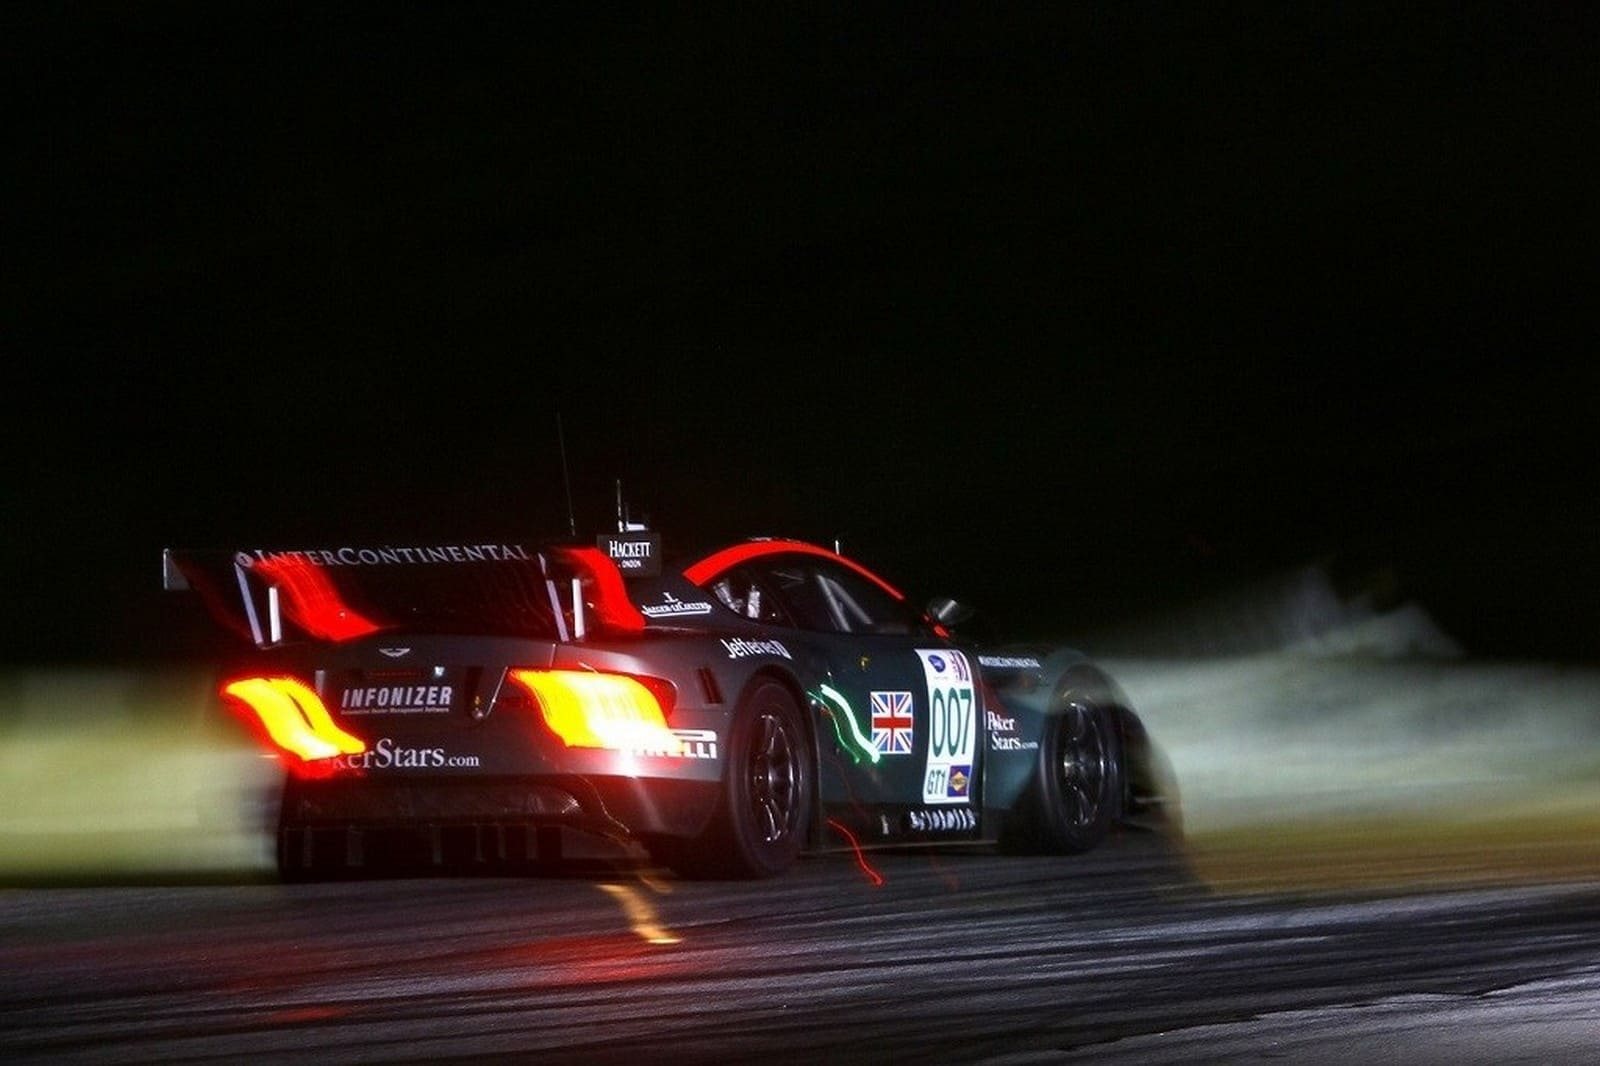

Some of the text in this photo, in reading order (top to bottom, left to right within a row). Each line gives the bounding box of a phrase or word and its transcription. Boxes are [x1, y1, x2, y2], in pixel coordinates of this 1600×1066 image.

[609, 540, 651, 557] HACKETT
[616, 559, 642, 568] ONDON
[341, 686, 452, 708] INFONIZER
[932, 687, 971, 757] 007
[330, 738, 480, 769] kerStars.com
[927, 770, 946, 795] GT1
